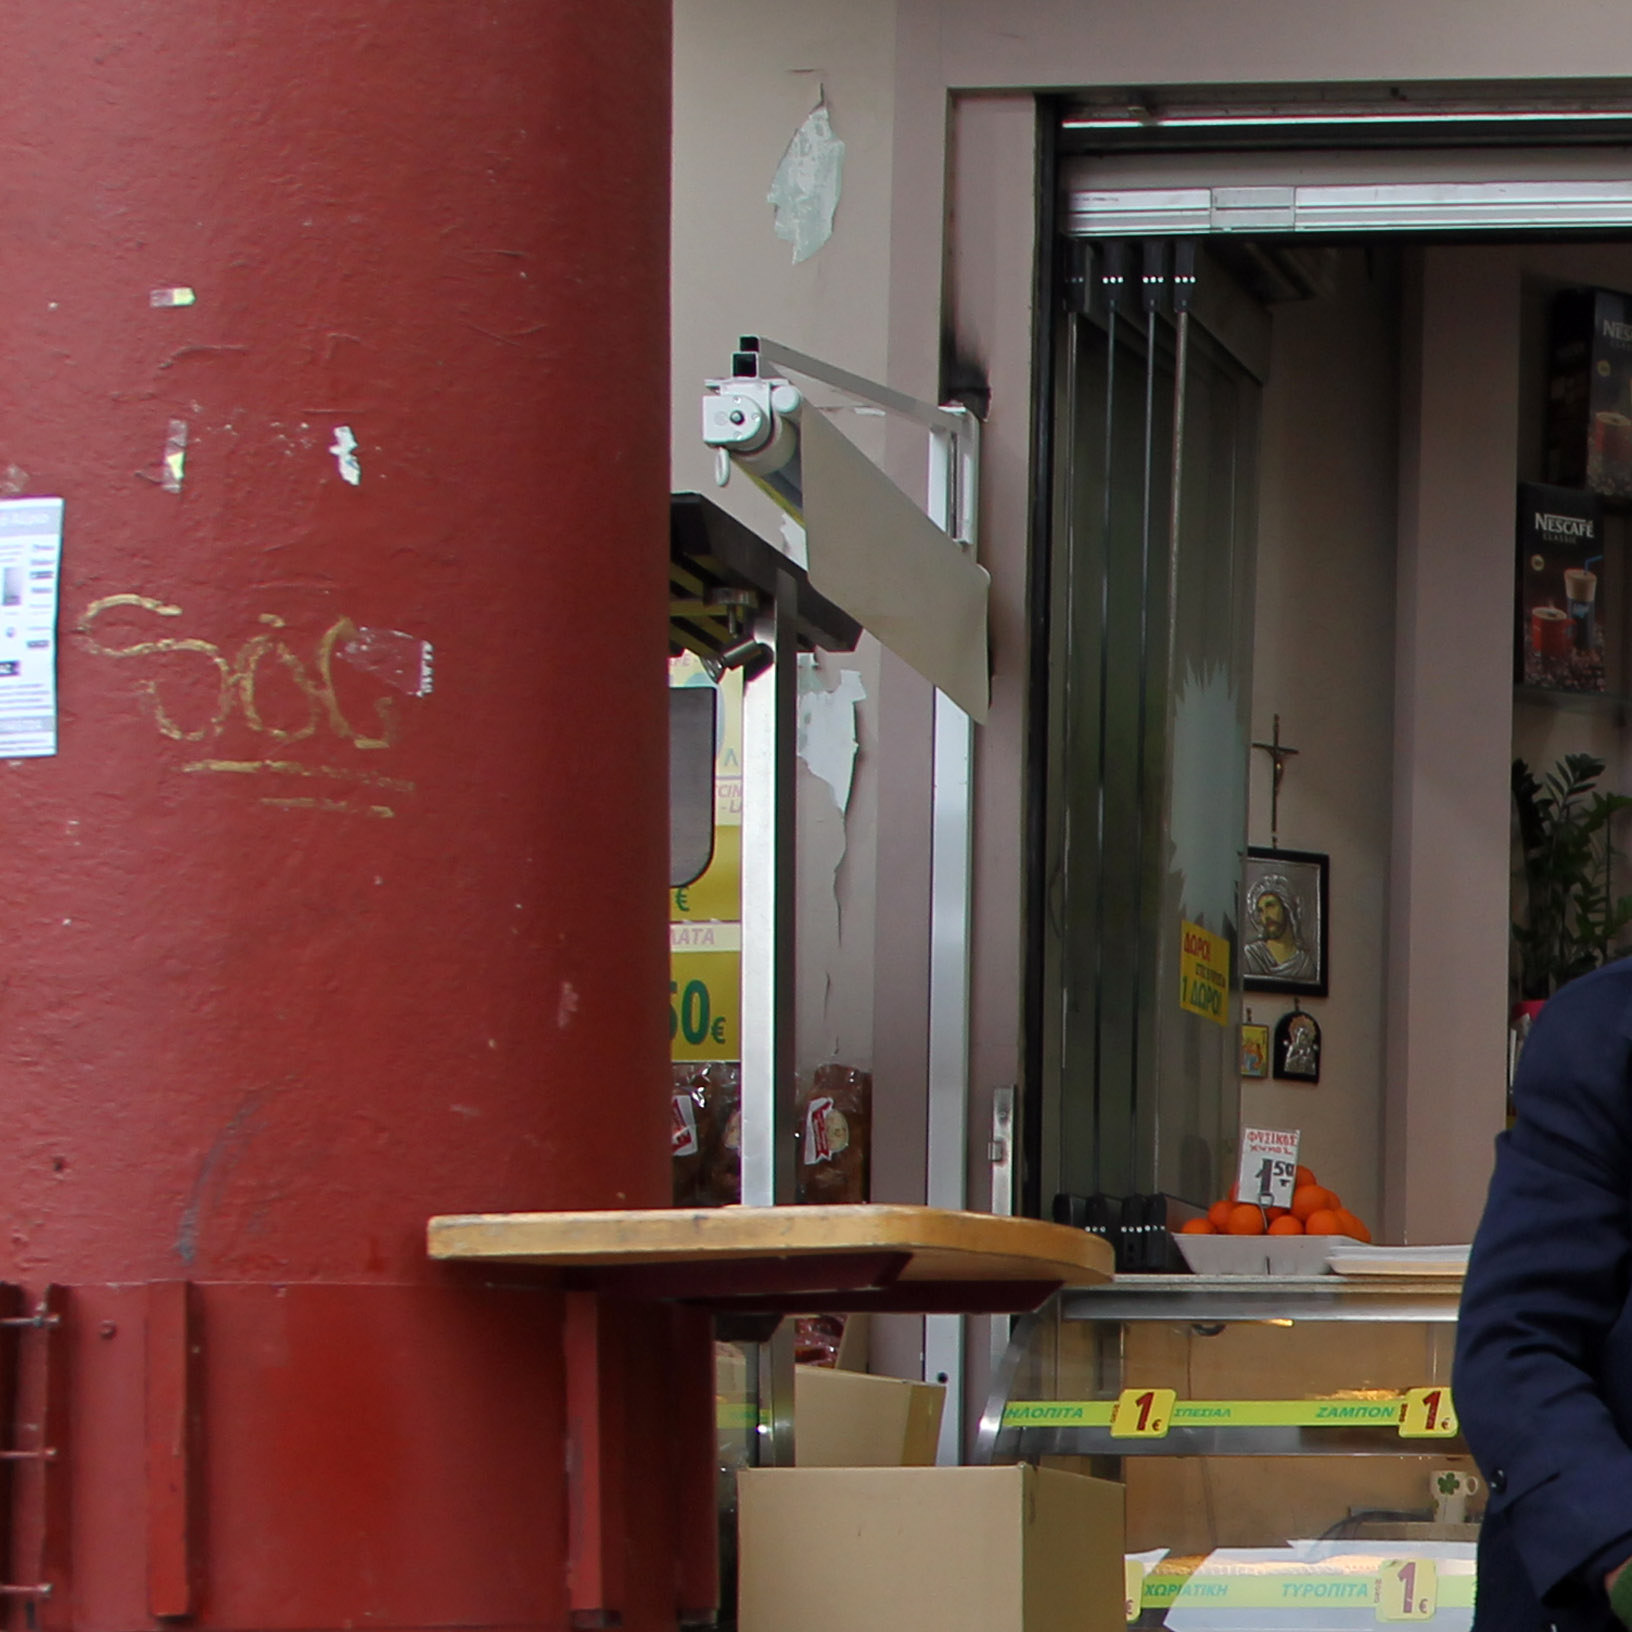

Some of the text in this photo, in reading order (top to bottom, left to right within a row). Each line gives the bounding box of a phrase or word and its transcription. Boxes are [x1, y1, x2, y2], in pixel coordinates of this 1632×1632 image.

[1534, 512, 1595, 538] NESCAFÉ
[1005, 1407, 1083, 1418] ΗΛΟΠΙΤΑ
[1174, 1409, 1231, 1418] ΣΠΕΣΙΑΛ
[1316, 1406, 1395, 1418] ΖΑΜΠΟΝ
[1144, 1584, 1229, 1597] ΧΩΡΙΑΤΙΚΗ
[1282, 1584, 1368, 1598] ΤΥΡΟΠΙΤΑ
